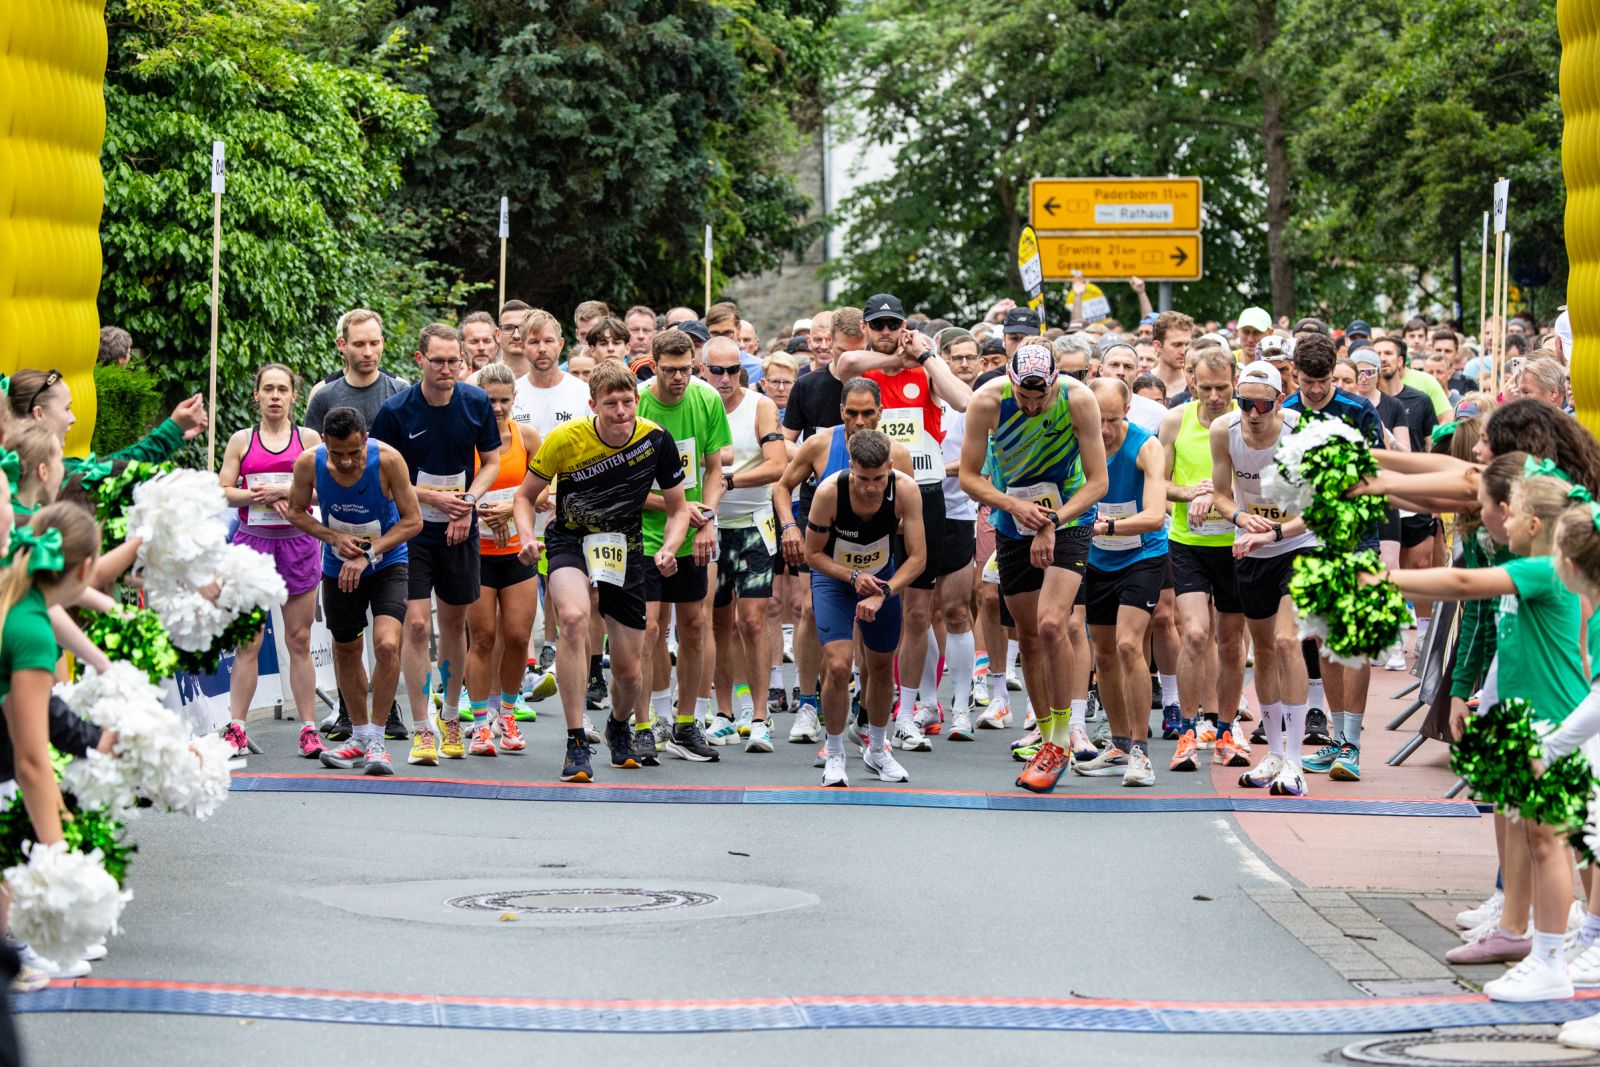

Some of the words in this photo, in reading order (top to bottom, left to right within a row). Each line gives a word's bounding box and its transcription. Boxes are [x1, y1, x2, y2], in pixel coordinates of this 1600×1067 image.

[1094, 188, 1158, 199] Paderborn
[1163, 188, 1173, 199] 11
[1120, 207, 1170, 219] Rathaus
[1058, 244, 1102, 256] Erwitte
[1108, 244, 1120, 255] 21
[1057, 259, 1102, 271] Geseke
[1112, 260, 1120, 270] 9
[881, 423, 915, 436] 1324
[571, 452, 626, 482] SALZKOTTEN
[625, 439, 652, 460] MARATHON
[592, 546, 623, 562] 1616
[845, 551, 880, 564] 1693
